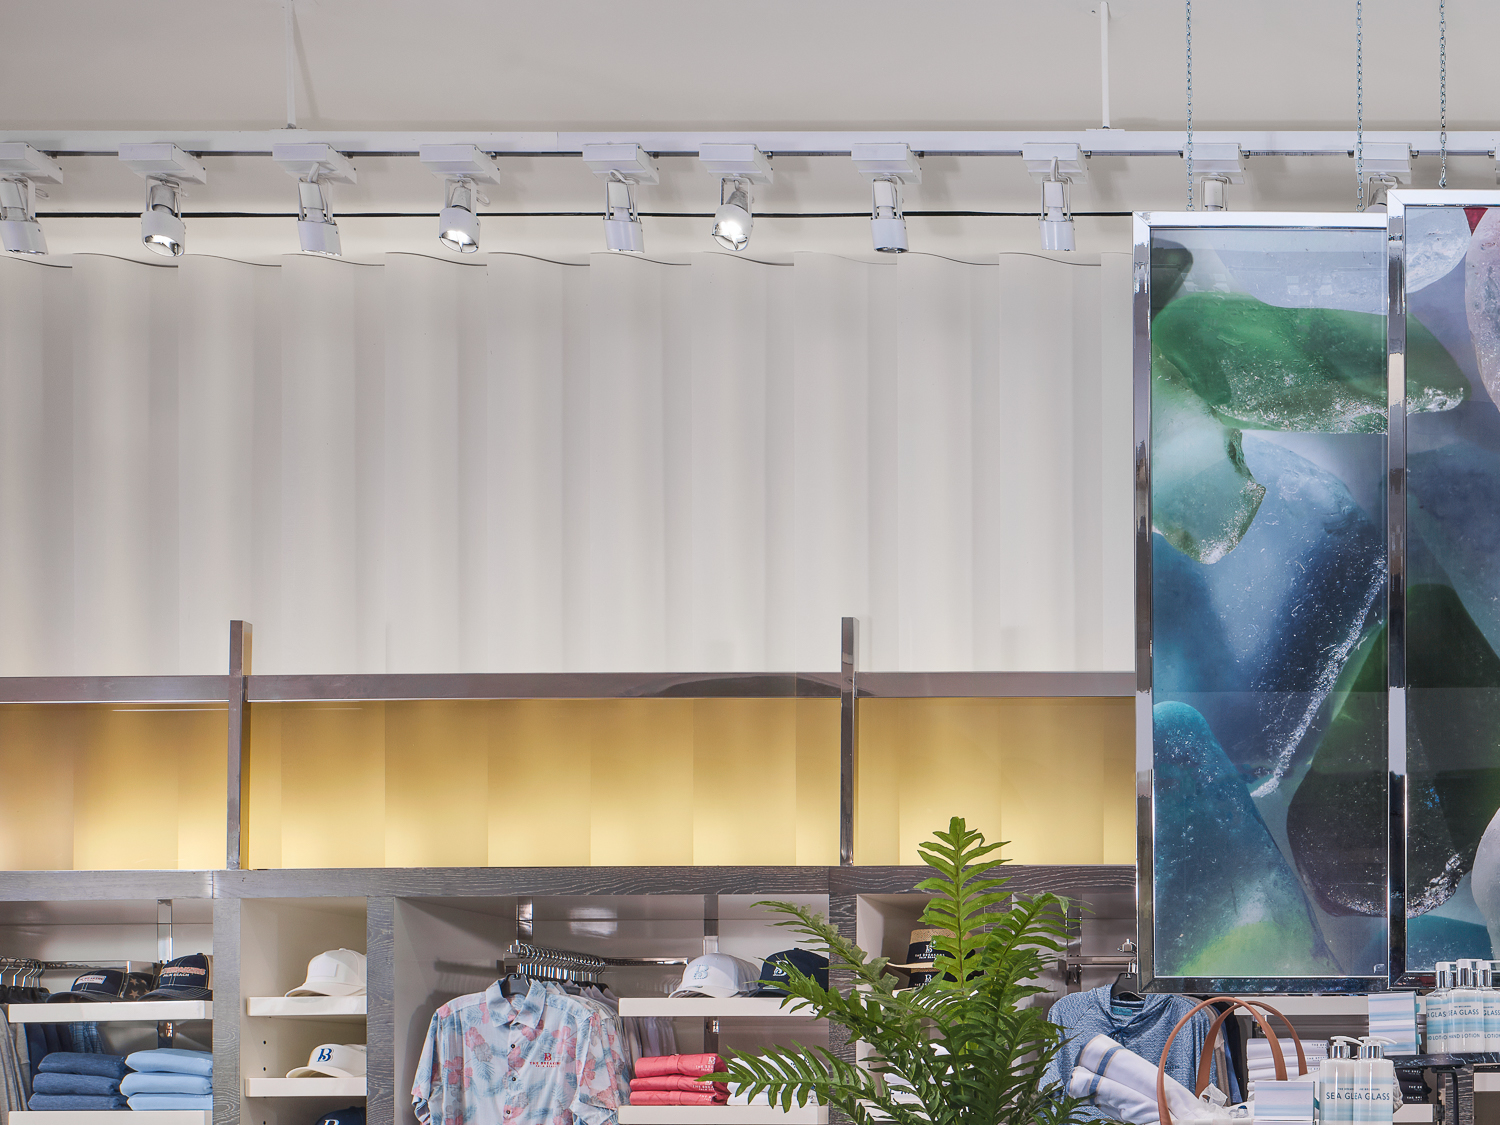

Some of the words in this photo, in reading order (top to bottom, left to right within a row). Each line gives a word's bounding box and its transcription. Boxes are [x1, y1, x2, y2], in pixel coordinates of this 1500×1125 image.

[316, 1047, 333, 1062] B
[1326, 1092, 1342, 1100] SEA
[1365, 1092, 1390, 1100] GLASS
